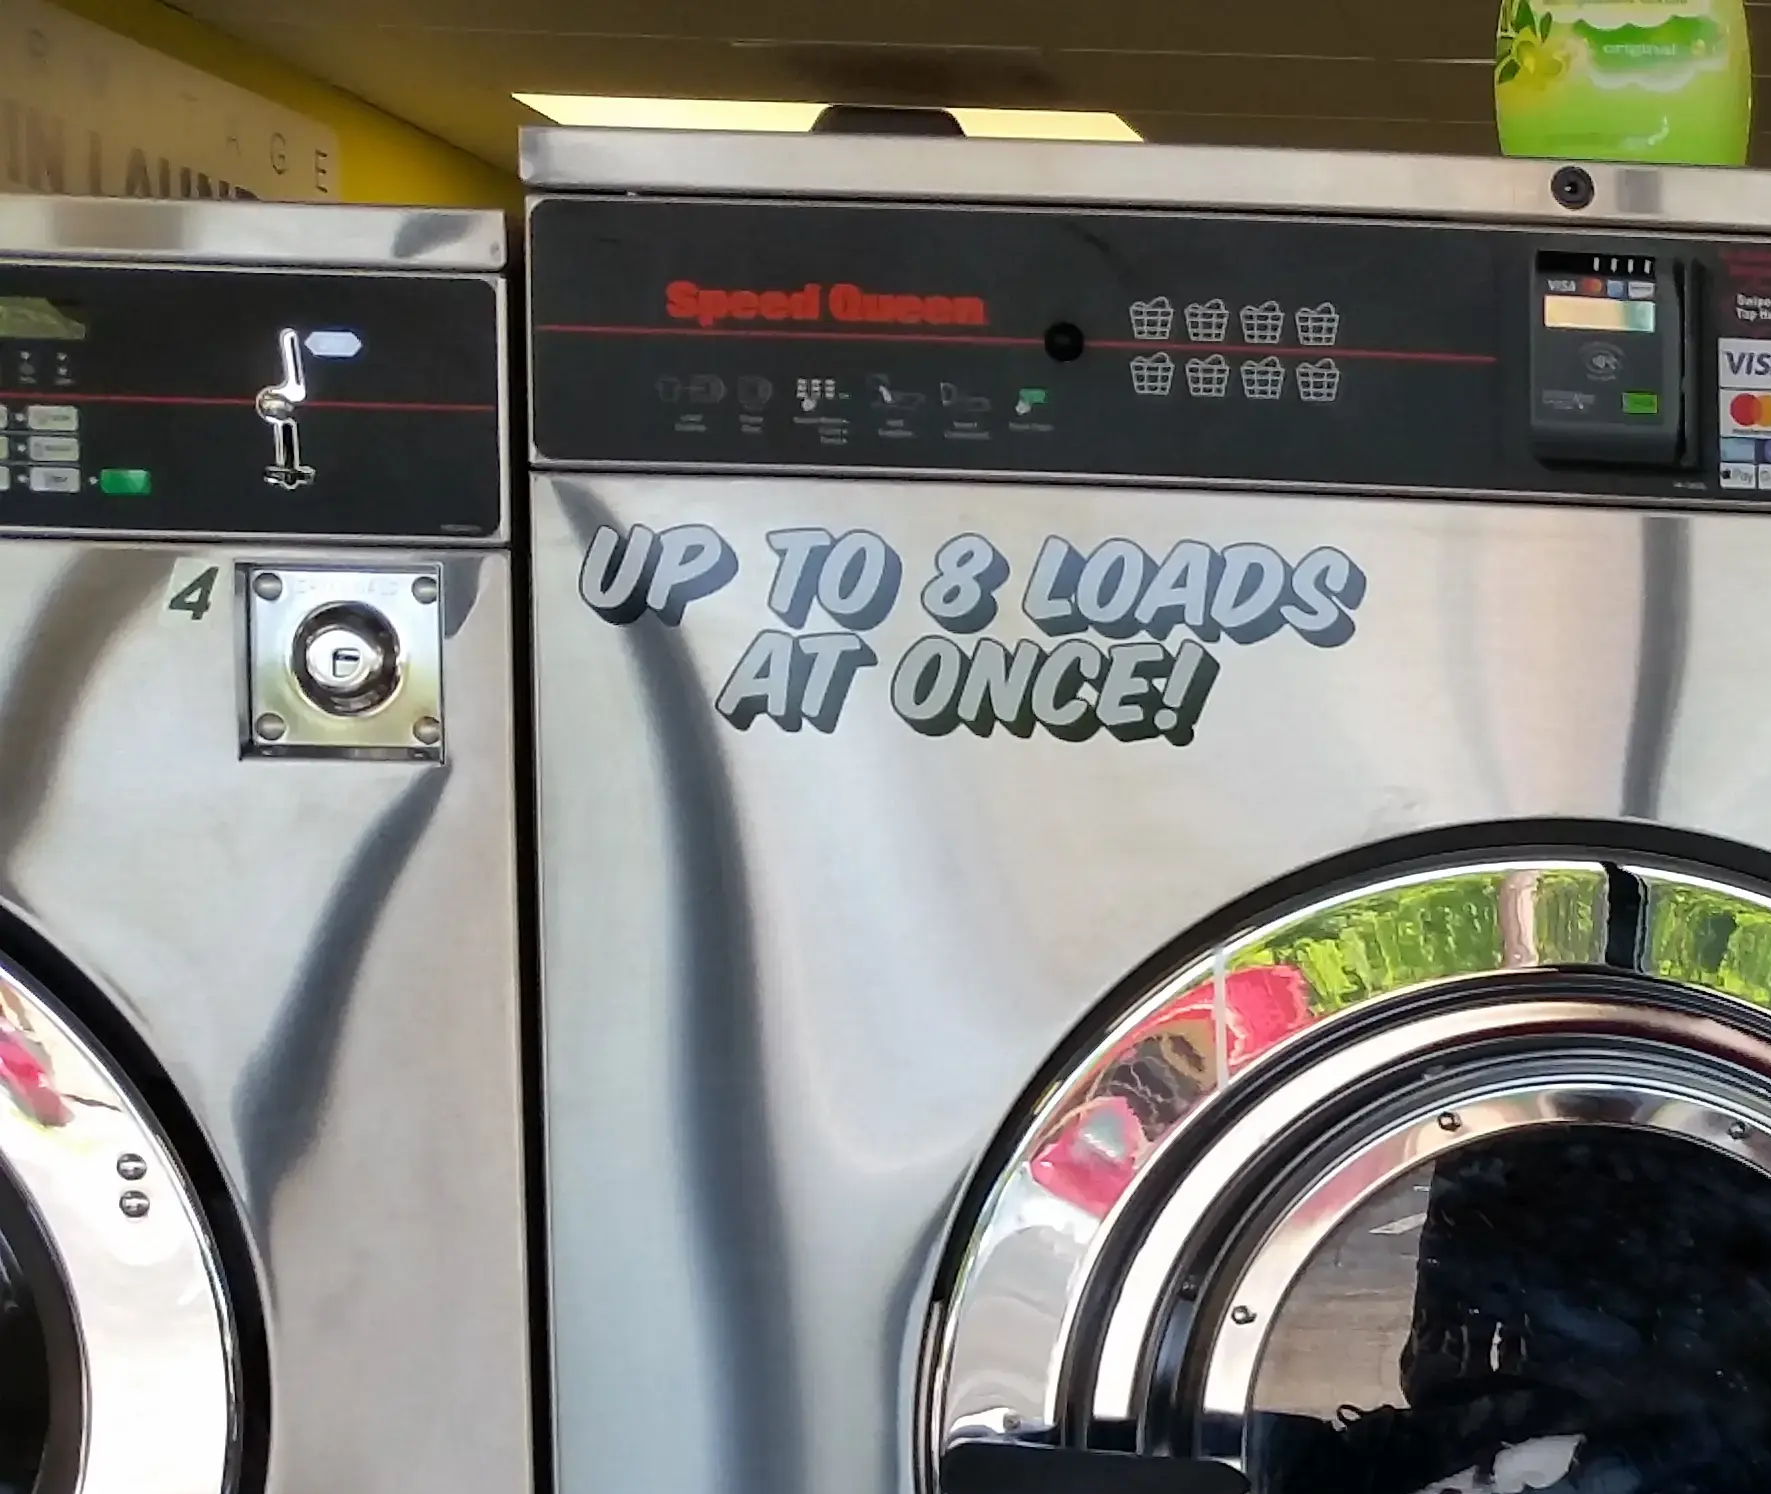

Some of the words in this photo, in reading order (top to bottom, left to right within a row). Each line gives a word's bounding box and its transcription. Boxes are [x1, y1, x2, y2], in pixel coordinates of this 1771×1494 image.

[665, 280, 820, 327] Speed
[828, 284, 988, 326] Queen
[168, 565, 219, 621] 4
[579, 522, 739, 627] UP
[765, 527, 903, 633] TO
[919, 531, 1010, 636] 8
[1021, 534, 1367, 649] LOADS
[716, 629, 878, 733] AT
[890, 634, 1221, 747] ONCE!
